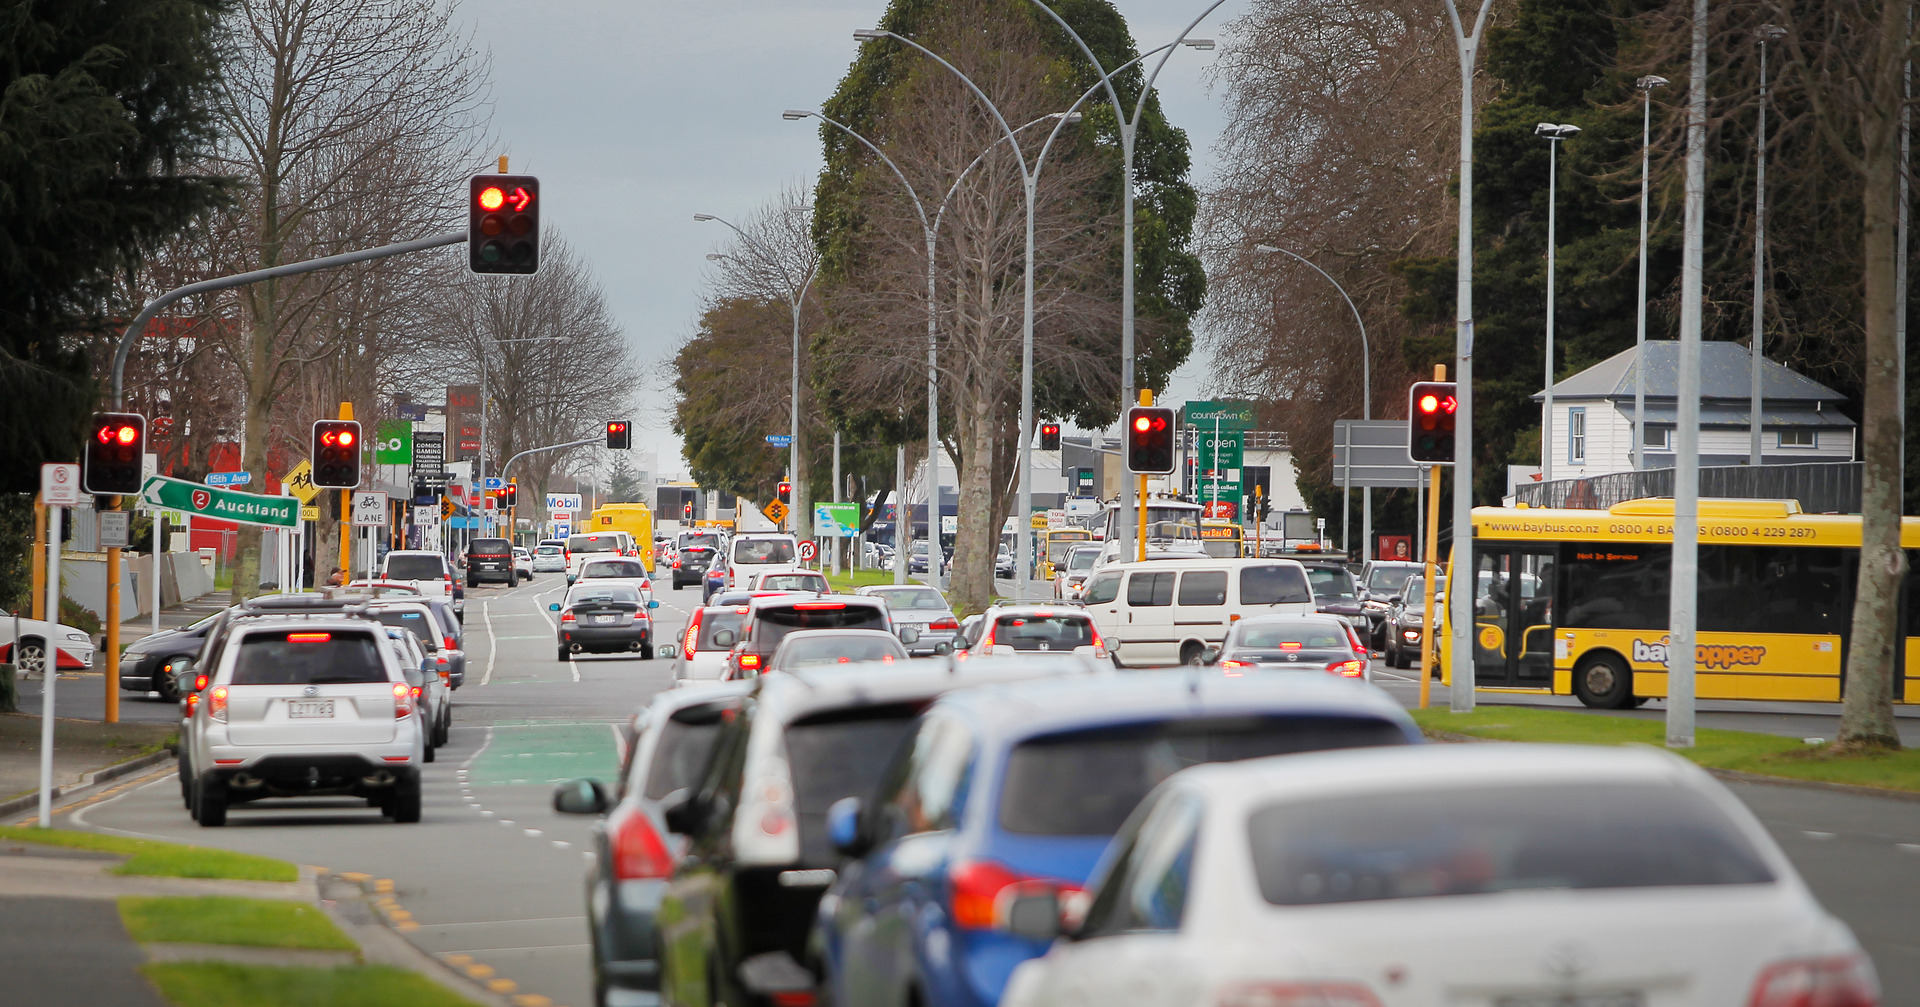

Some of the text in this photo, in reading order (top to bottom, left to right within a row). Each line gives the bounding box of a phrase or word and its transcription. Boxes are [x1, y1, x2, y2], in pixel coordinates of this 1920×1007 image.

[1191, 410, 1238, 420] countdown
[209, 474, 247, 483] 15th Ave
[1080, 478, 1093, 486] HUB
[196, 493, 205, 505] 2
[546, 498, 578, 508] Mobil
[215, 499, 289, 518] Auckland
[357, 514, 383, 522] LANE
[1222, 528, 1232, 537] 40
[1490, 522, 1816, 539] www.baybus.co.nz 0800 4 BAS (0800 4 229 287)
[1606, 553, 1639, 561] Service
[1634, 638, 1766, 669] baopper
